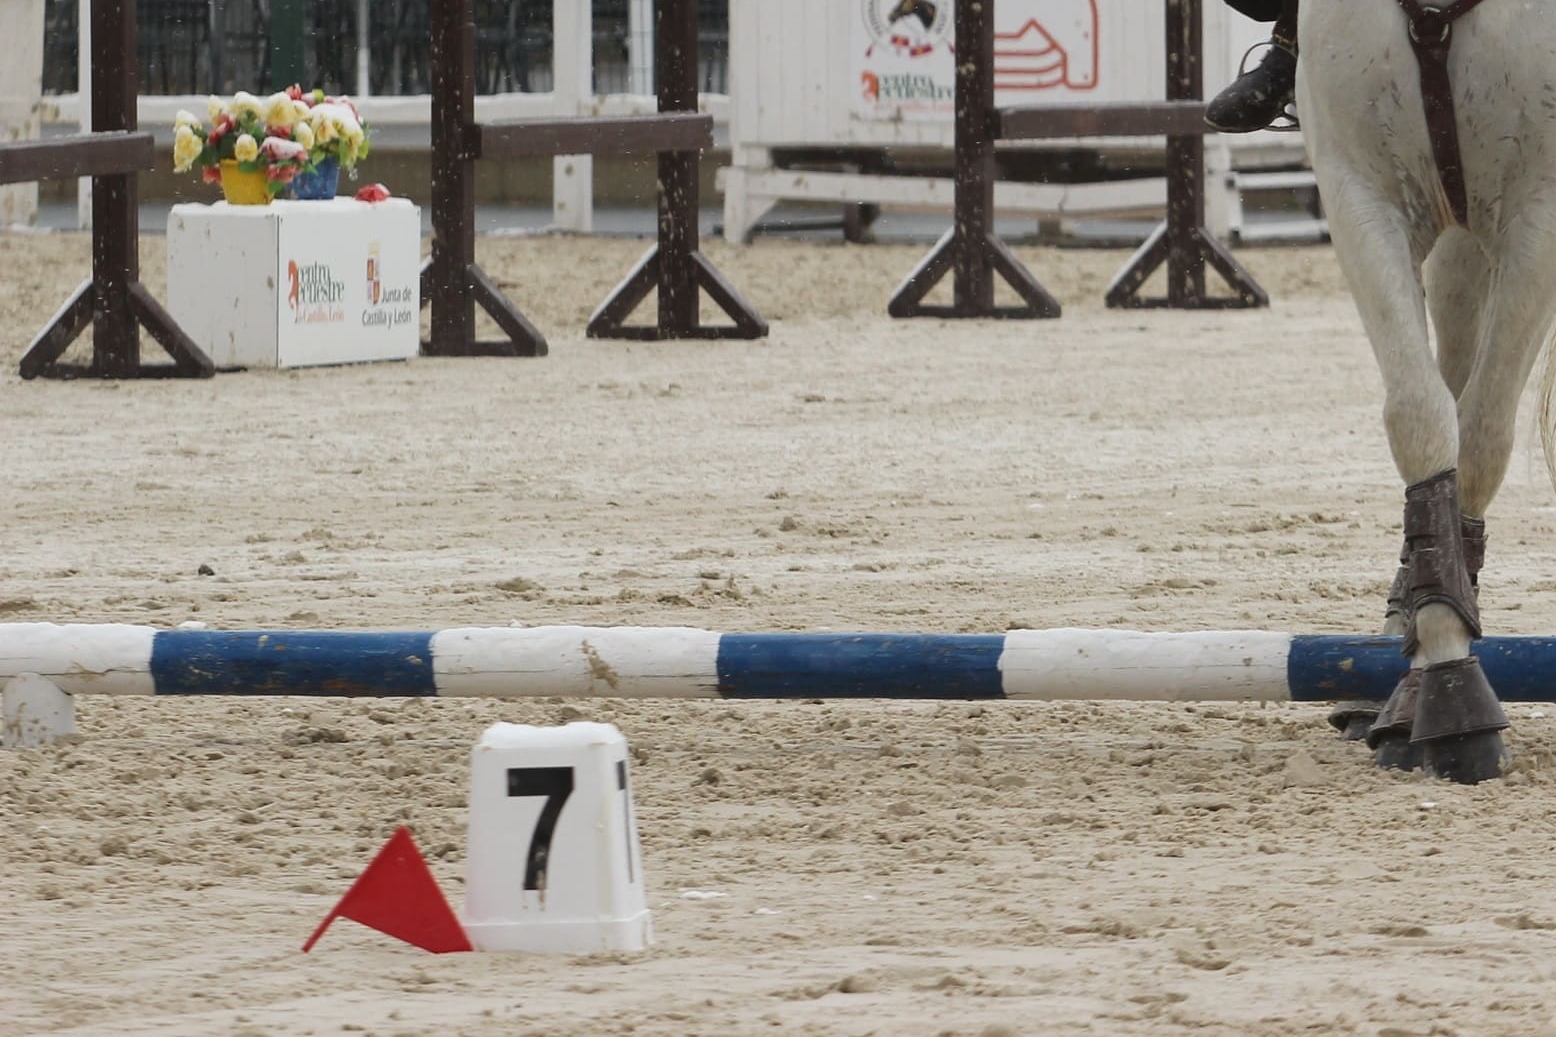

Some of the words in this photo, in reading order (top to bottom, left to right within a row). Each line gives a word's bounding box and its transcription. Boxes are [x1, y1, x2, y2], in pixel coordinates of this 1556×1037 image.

[382, 288, 401, 303] Junta
[402, 285, 412, 302] de
[362, 308, 387, 326] Castilla
[394, 307, 412, 324] León
[507, 767, 575, 890] 7
